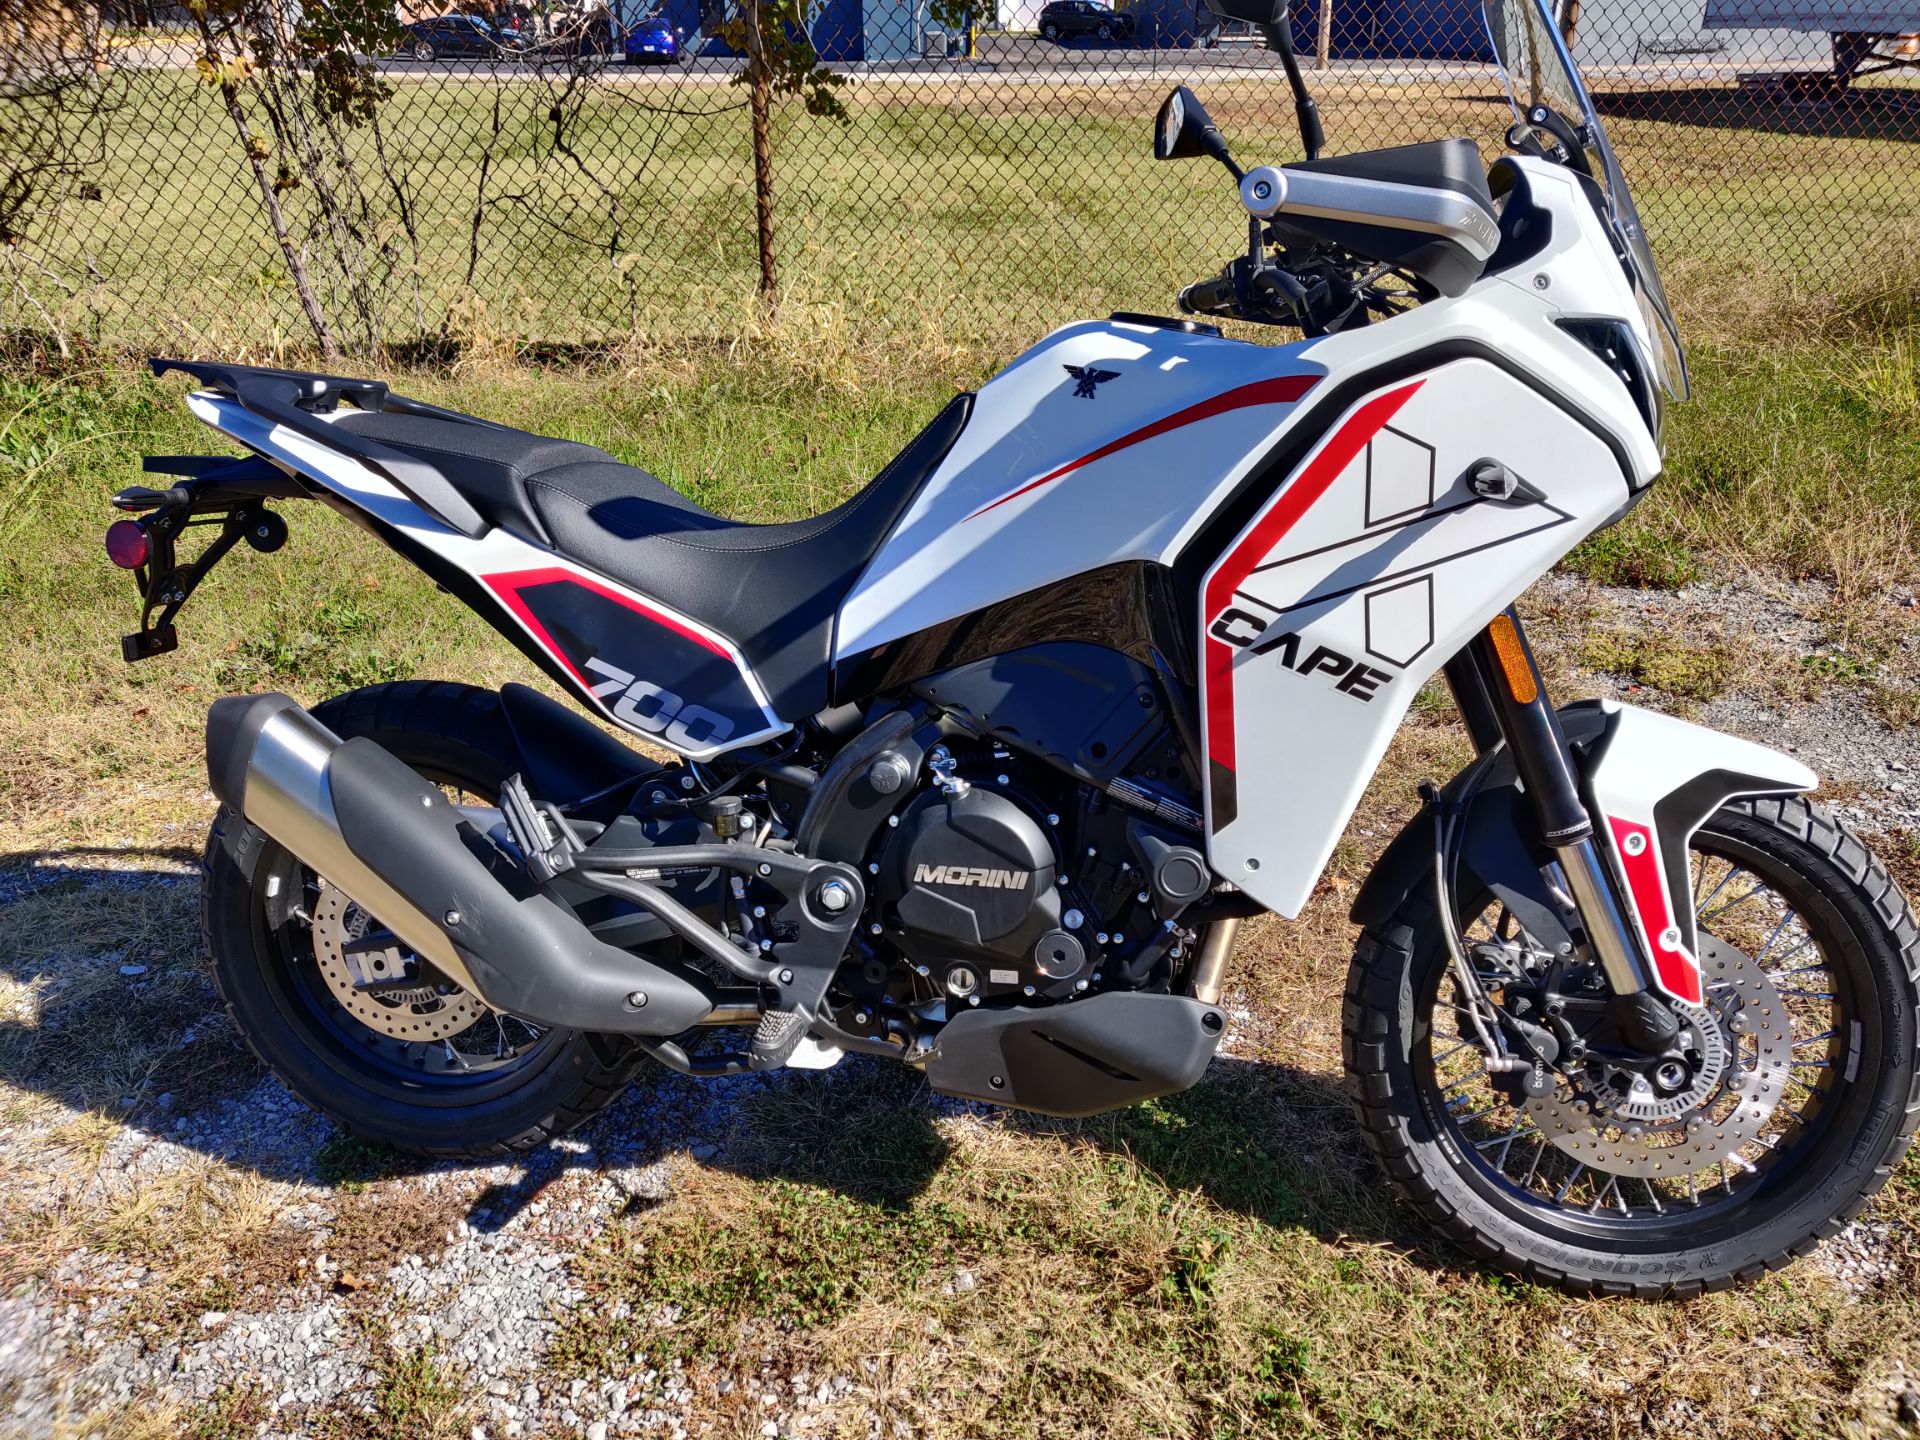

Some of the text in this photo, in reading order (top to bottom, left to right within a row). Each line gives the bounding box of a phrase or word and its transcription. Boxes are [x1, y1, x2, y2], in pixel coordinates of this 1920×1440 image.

[1210, 608, 1394, 703] CAPE
[584, 656, 735, 751] 700
[913, 864, 1029, 890] MORINI
[1726, 820, 1852, 898] PIRELLI
[1502, 1231, 1688, 1275] SCORPION
